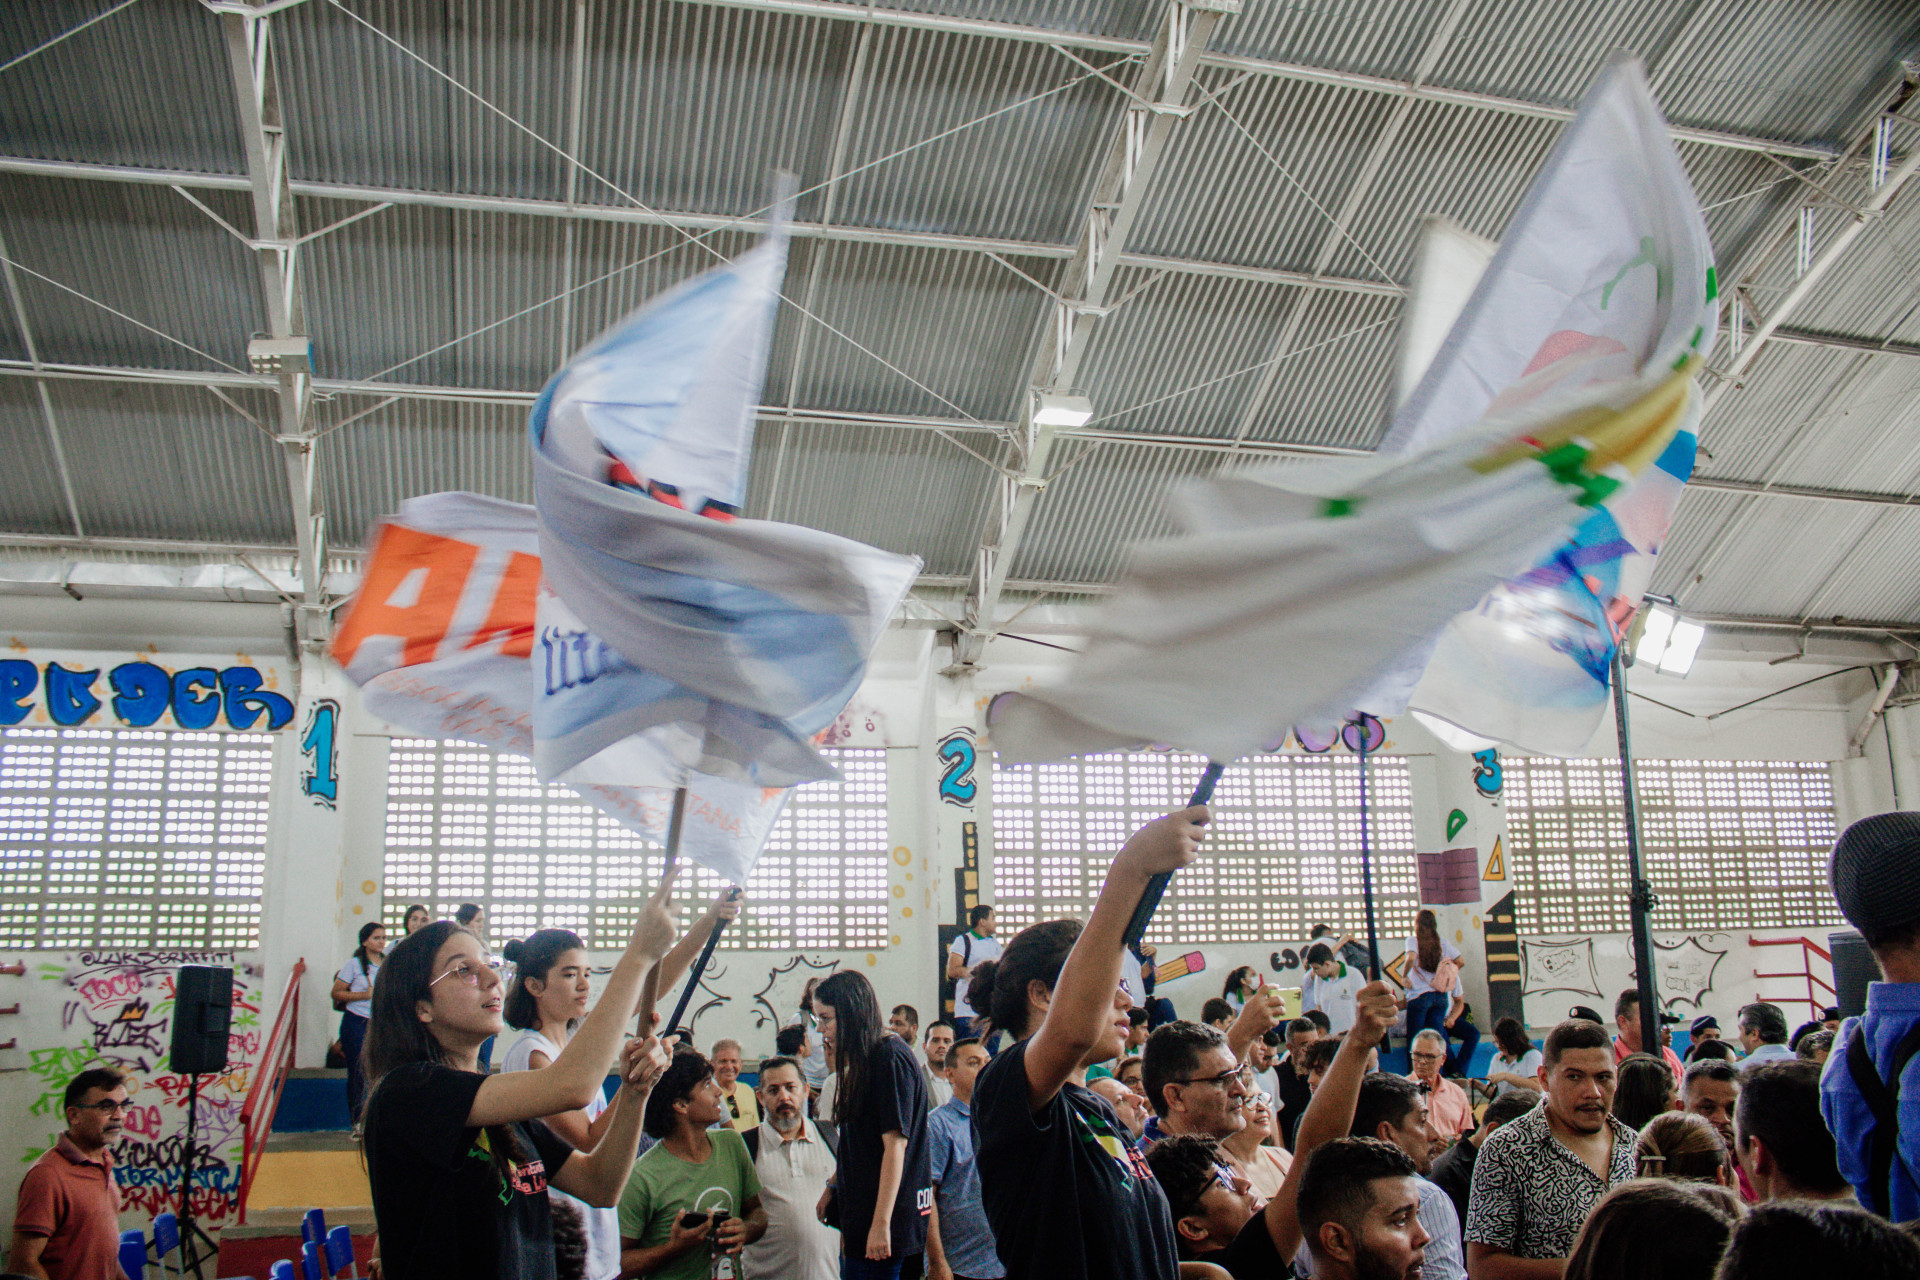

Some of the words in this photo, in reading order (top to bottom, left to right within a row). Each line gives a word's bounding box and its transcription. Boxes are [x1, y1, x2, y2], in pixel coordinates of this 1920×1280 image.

[939, 730, 977, 806] 2
[1472, 748, 1504, 797] 3
[79, 972, 143, 1004] FOCO
